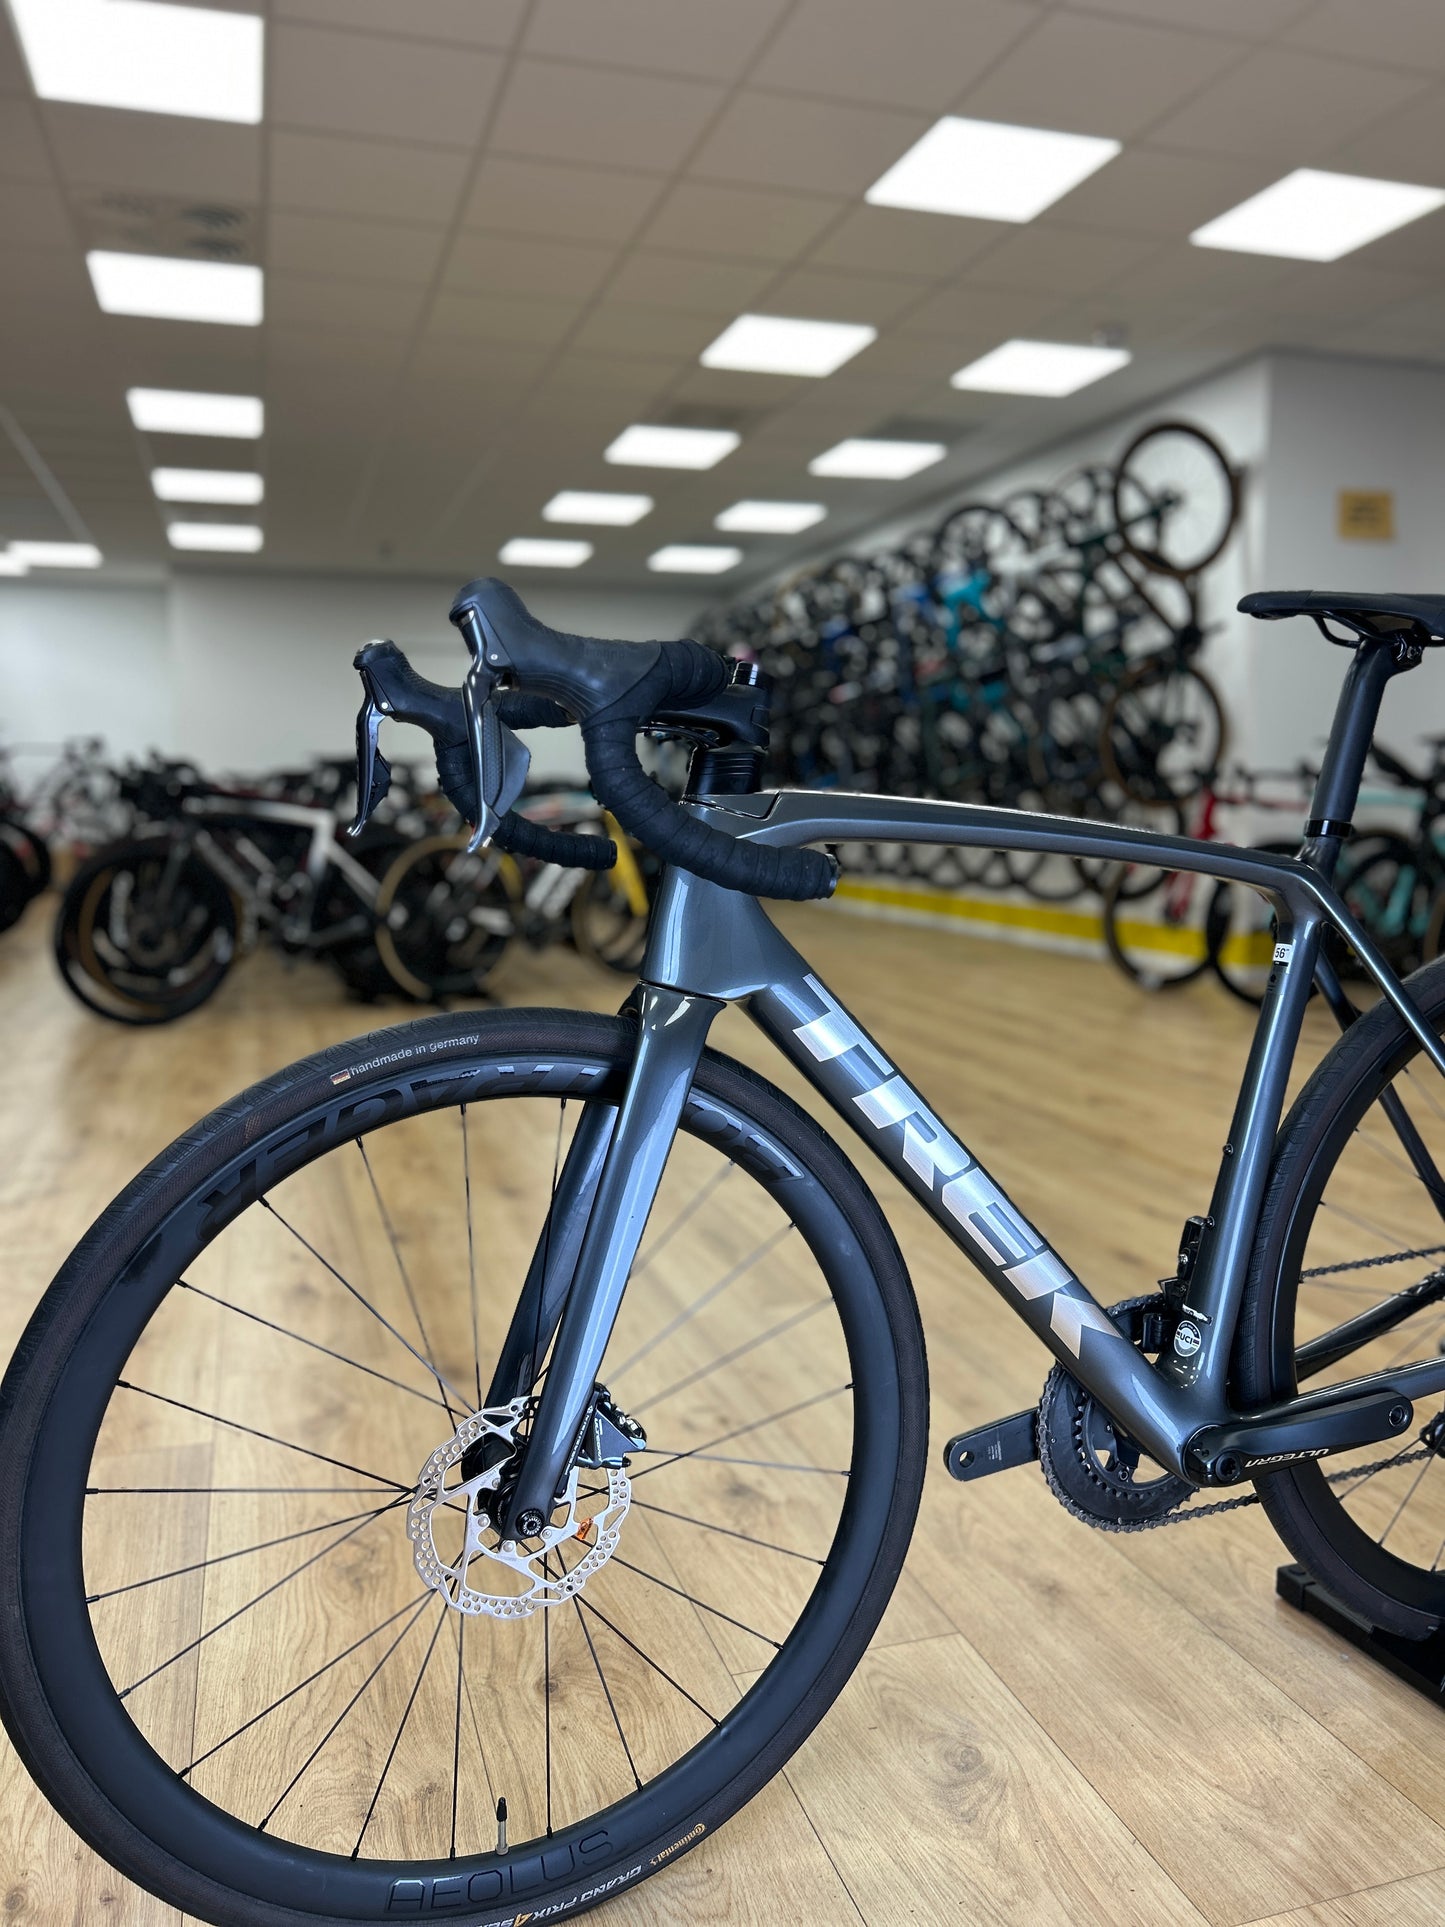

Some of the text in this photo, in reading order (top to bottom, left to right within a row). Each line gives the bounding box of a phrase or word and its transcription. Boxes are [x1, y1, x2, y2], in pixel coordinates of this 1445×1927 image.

[350, 1035, 480, 1076] handmade in germany
[792, 973, 1122, 1359] TREK
[1179, 1332, 1194, 1345] UCI
[1244, 1448, 1330, 1468] ULTEGRA
[657, 1822, 706, 1862] Continental
[384, 1830, 615, 1912] AEOLUS
[580, 1864, 642, 1902] GRAND
[532, 1896, 577, 1921] PRIX
